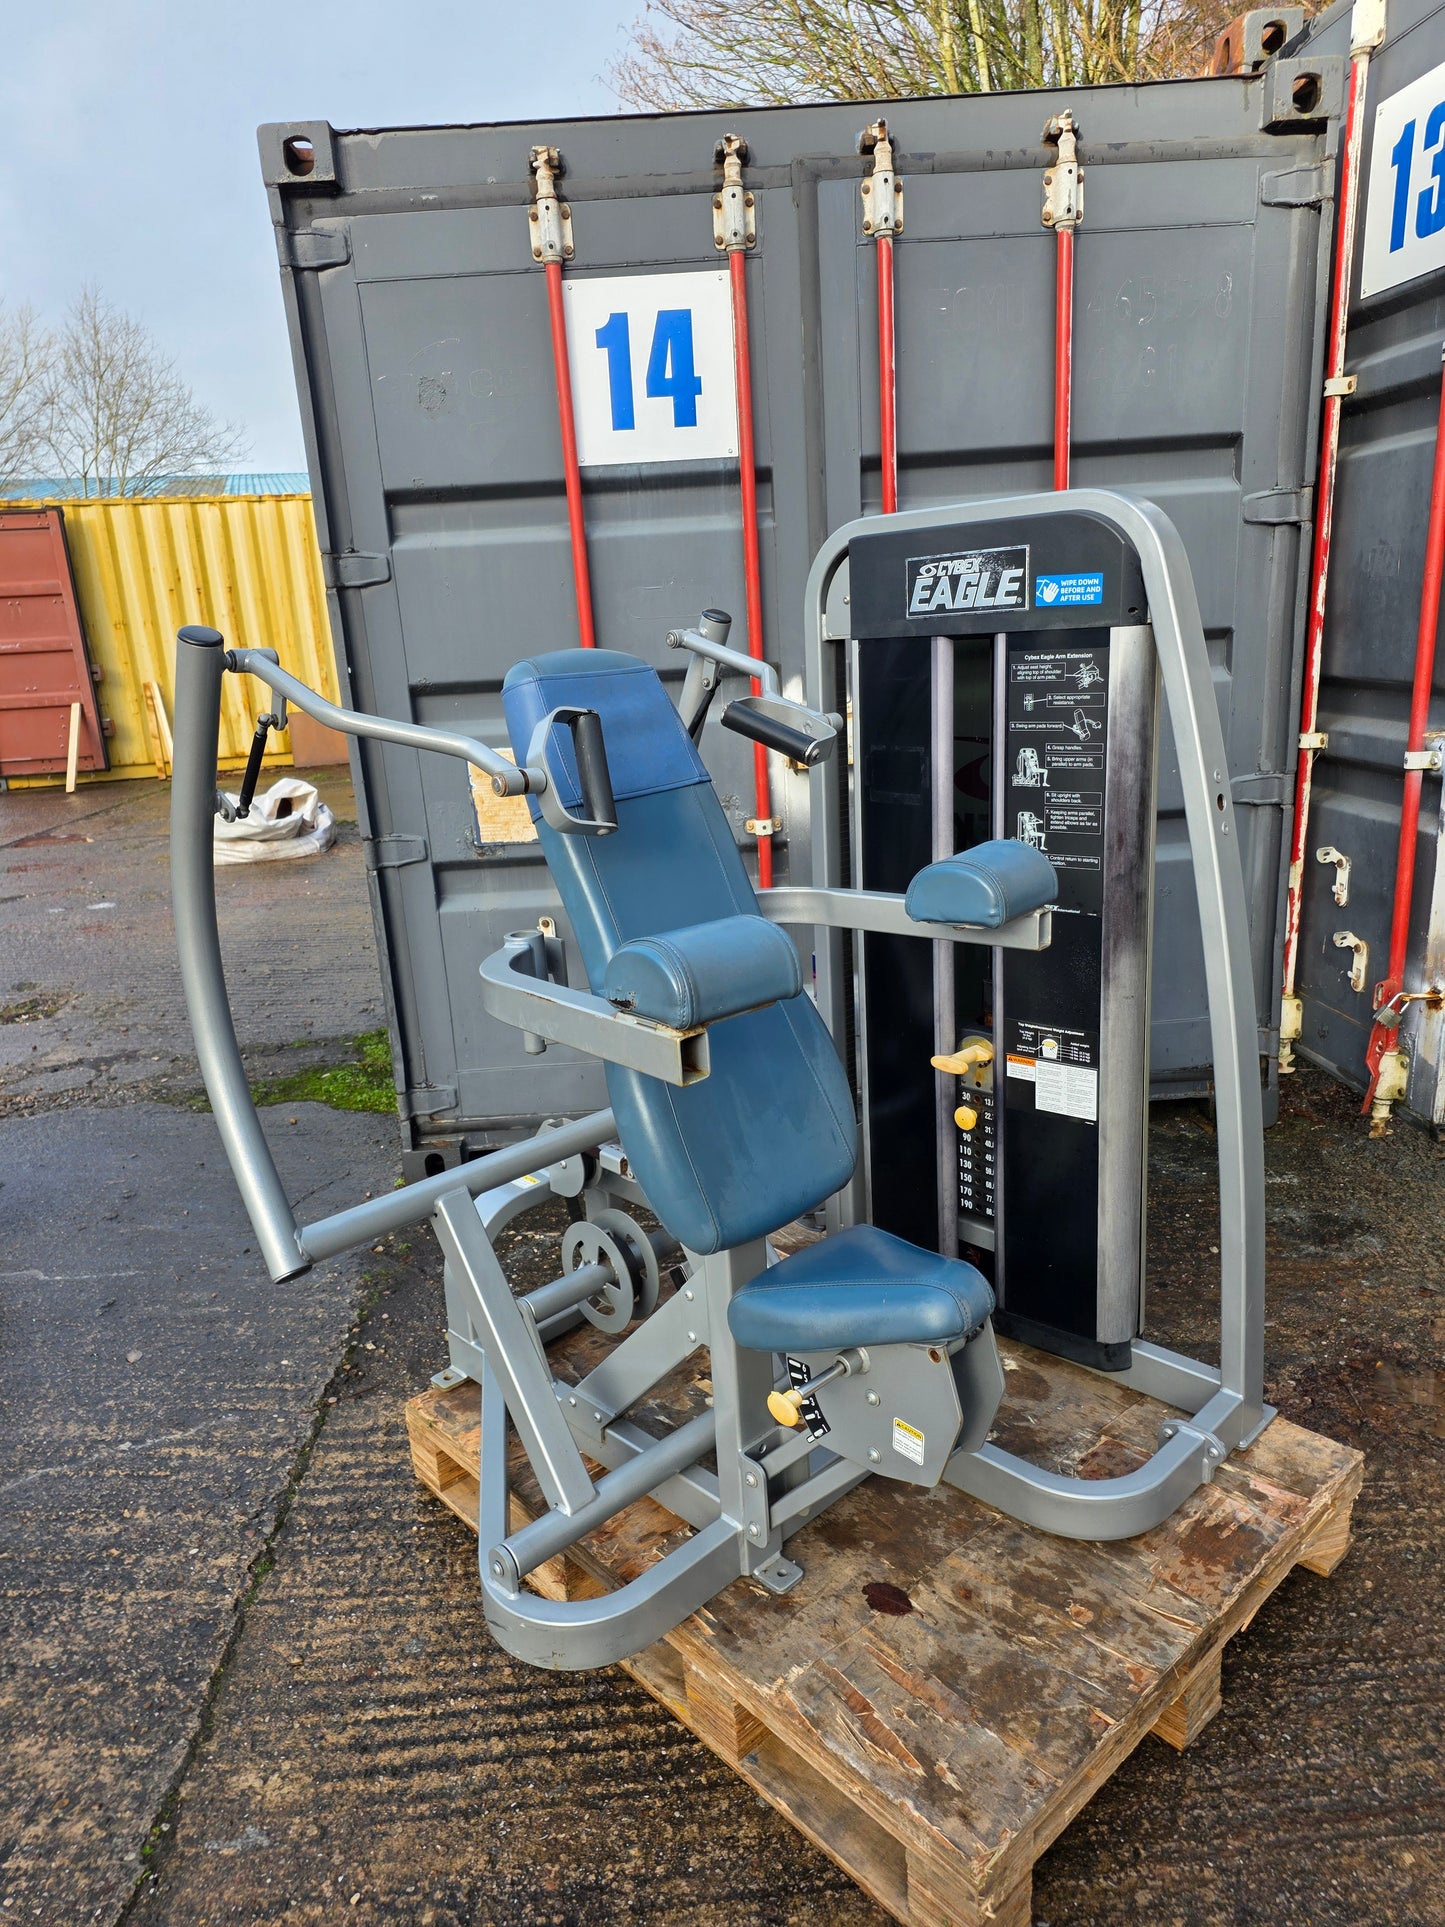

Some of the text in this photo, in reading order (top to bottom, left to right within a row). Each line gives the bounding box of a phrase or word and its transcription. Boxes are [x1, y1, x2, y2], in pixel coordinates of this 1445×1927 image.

[595, 308, 702, 431] 14
[937, 558, 982, 576] CYBEX
[910, 568, 1024, 612] EAGLE
[962, 1092, 970, 1100] 30
[963, 1133, 971, 1142] 90
[960, 1145, 971, 1156] 110
[960, 1159, 972, 1169] 130
[960, 1172, 972, 1182] 150
[960, 1185, 972, 1196] 170
[986, 1194, 994, 1203] 77.
[961, 1198, 972, 1209] 190
[802, 1364, 806, 1372] 6
[804, 1374, 808, 1382] 5
[810, 1397, 815, 1406] 3
[815, 1410, 821, 1419] 2
[822, 1424, 828, 1432] 1
